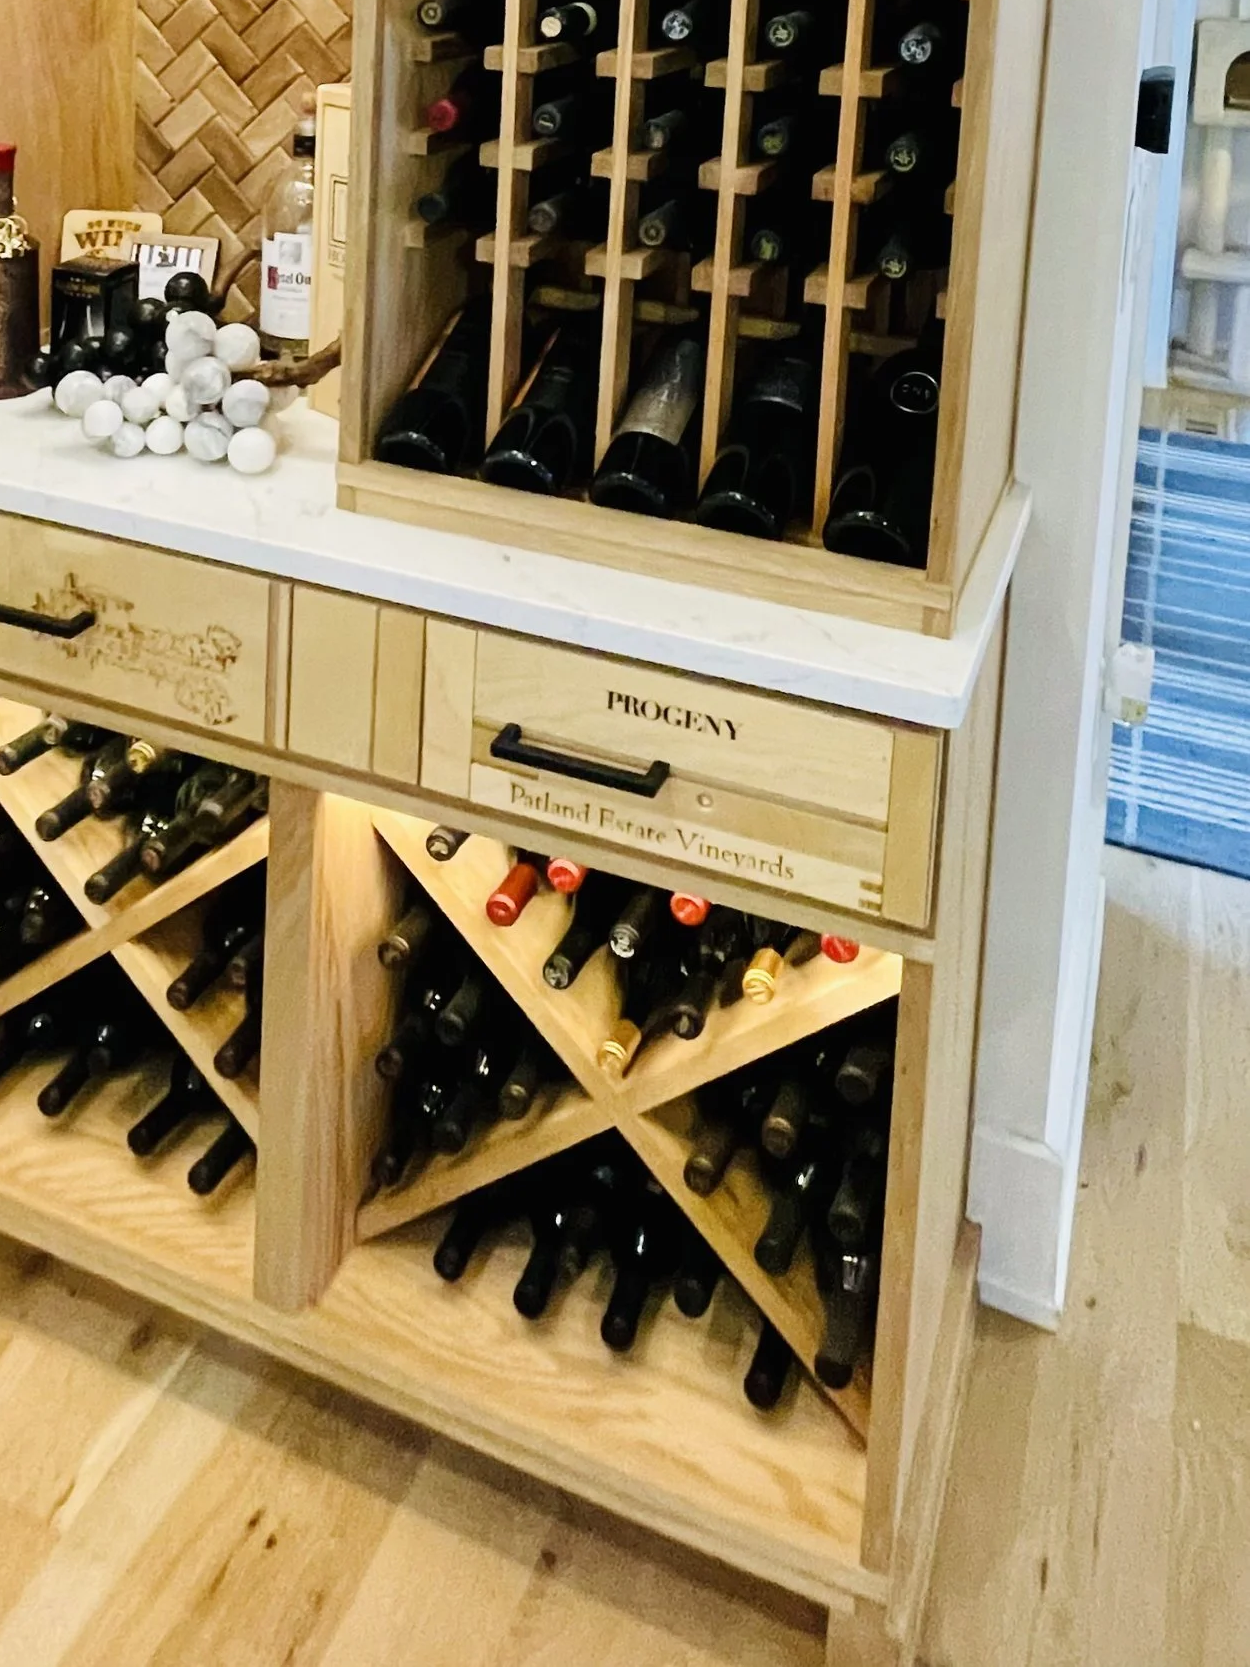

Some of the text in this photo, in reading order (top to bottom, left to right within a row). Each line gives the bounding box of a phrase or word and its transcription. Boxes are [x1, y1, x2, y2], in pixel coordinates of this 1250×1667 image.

[606, 689, 744, 741] PROGENY
[509, 782, 795, 880] Patland Estate Vineyards
